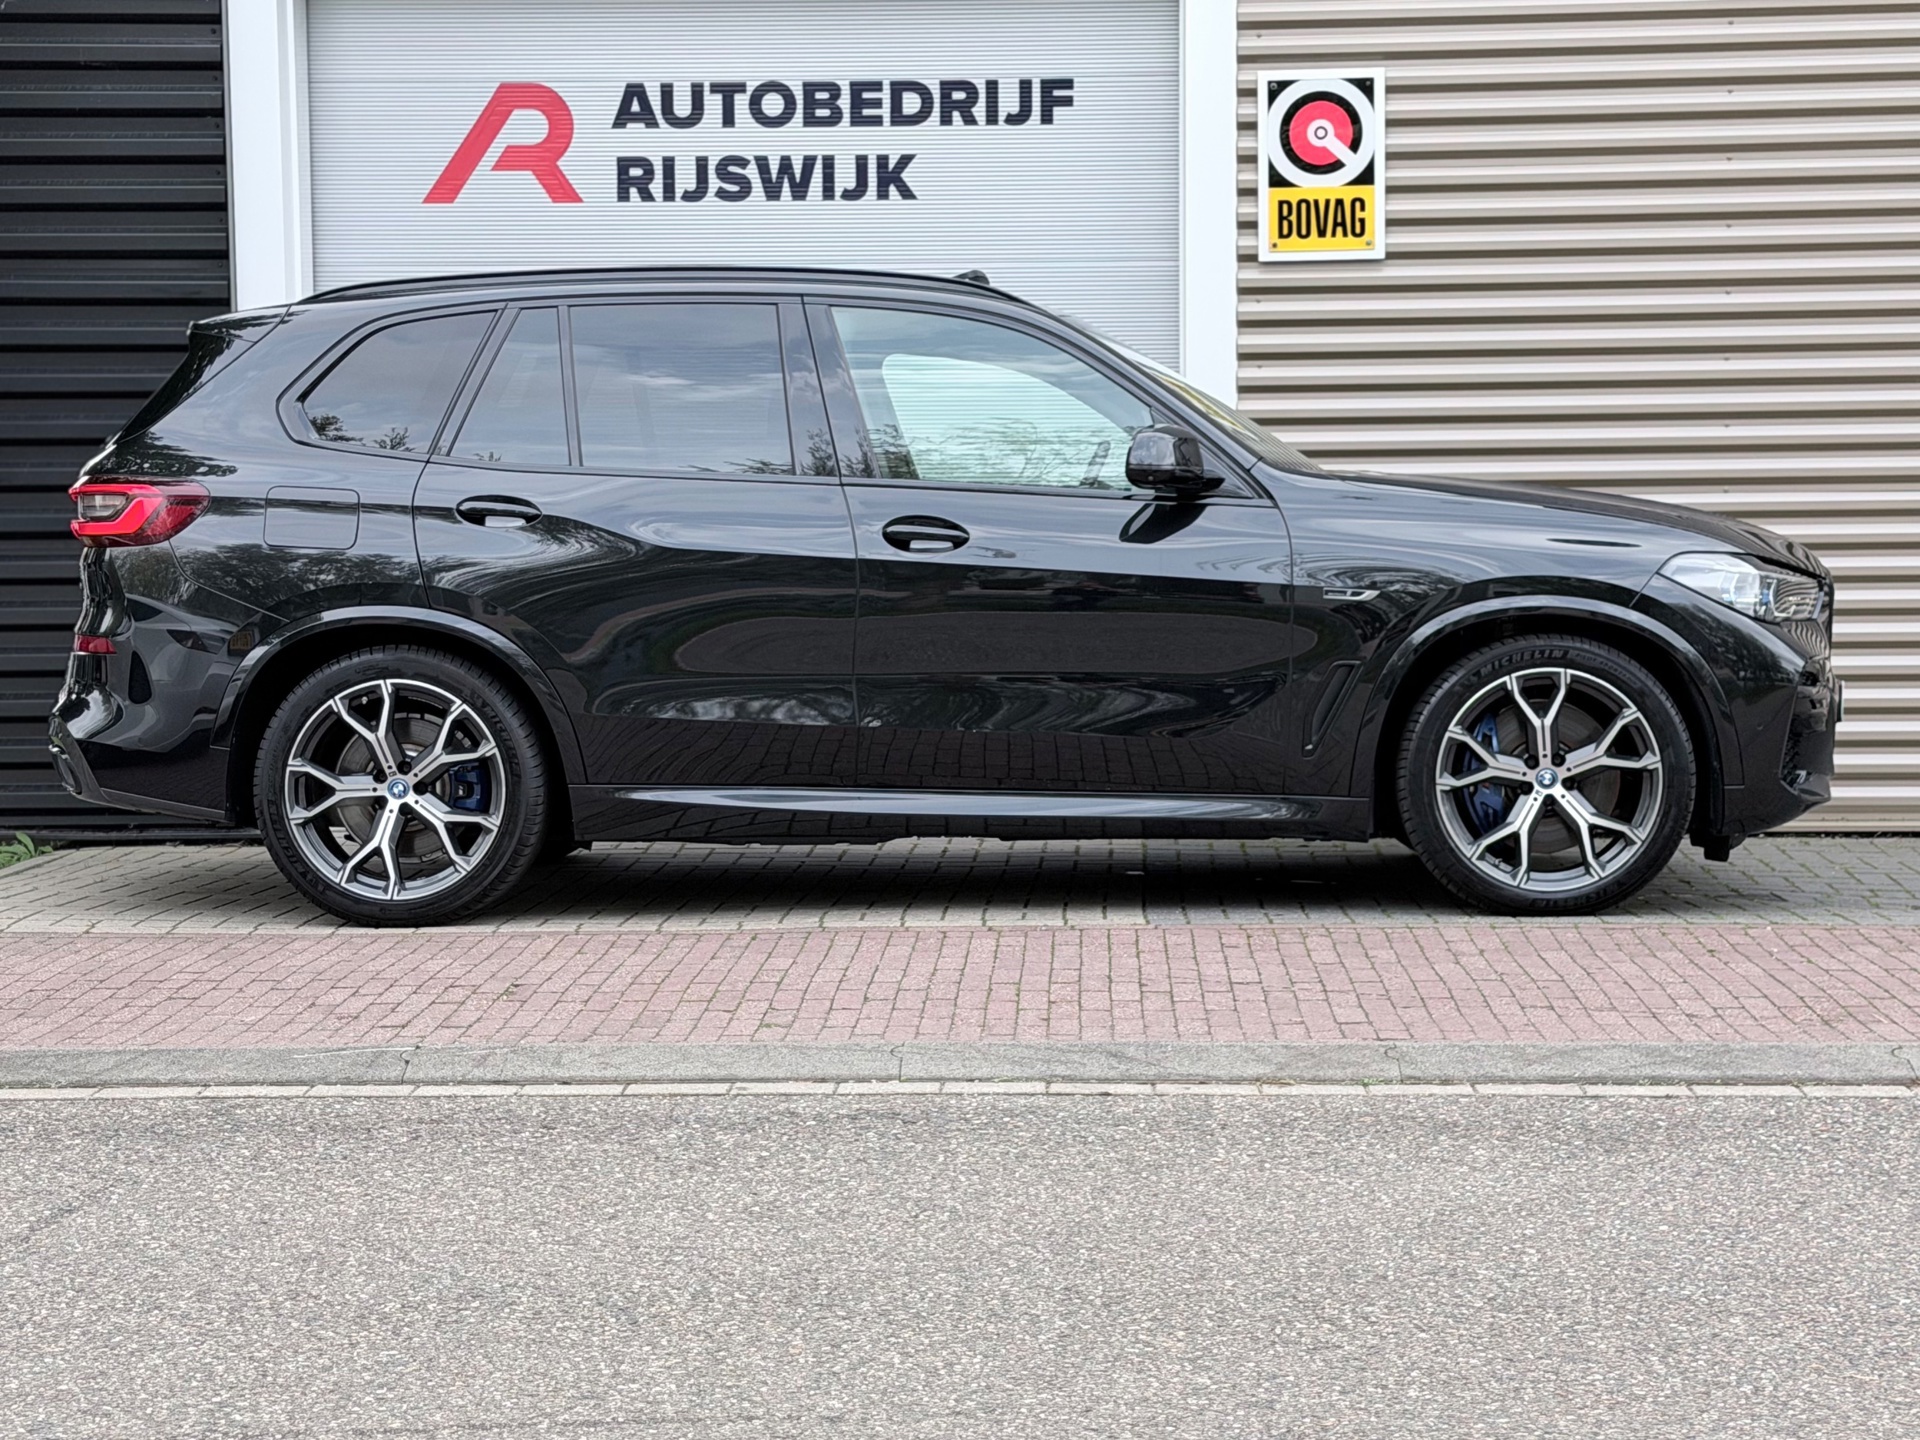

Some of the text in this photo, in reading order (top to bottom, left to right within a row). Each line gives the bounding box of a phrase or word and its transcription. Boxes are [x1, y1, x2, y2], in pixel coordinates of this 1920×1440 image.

[611, 78, 1075, 130] AUTOBEDRIJF
[615, 153, 919, 203] RIJSWIJK
[1277, 197, 1367, 240] BOVAG
[1479, 648, 1565, 677] MICHELIN
